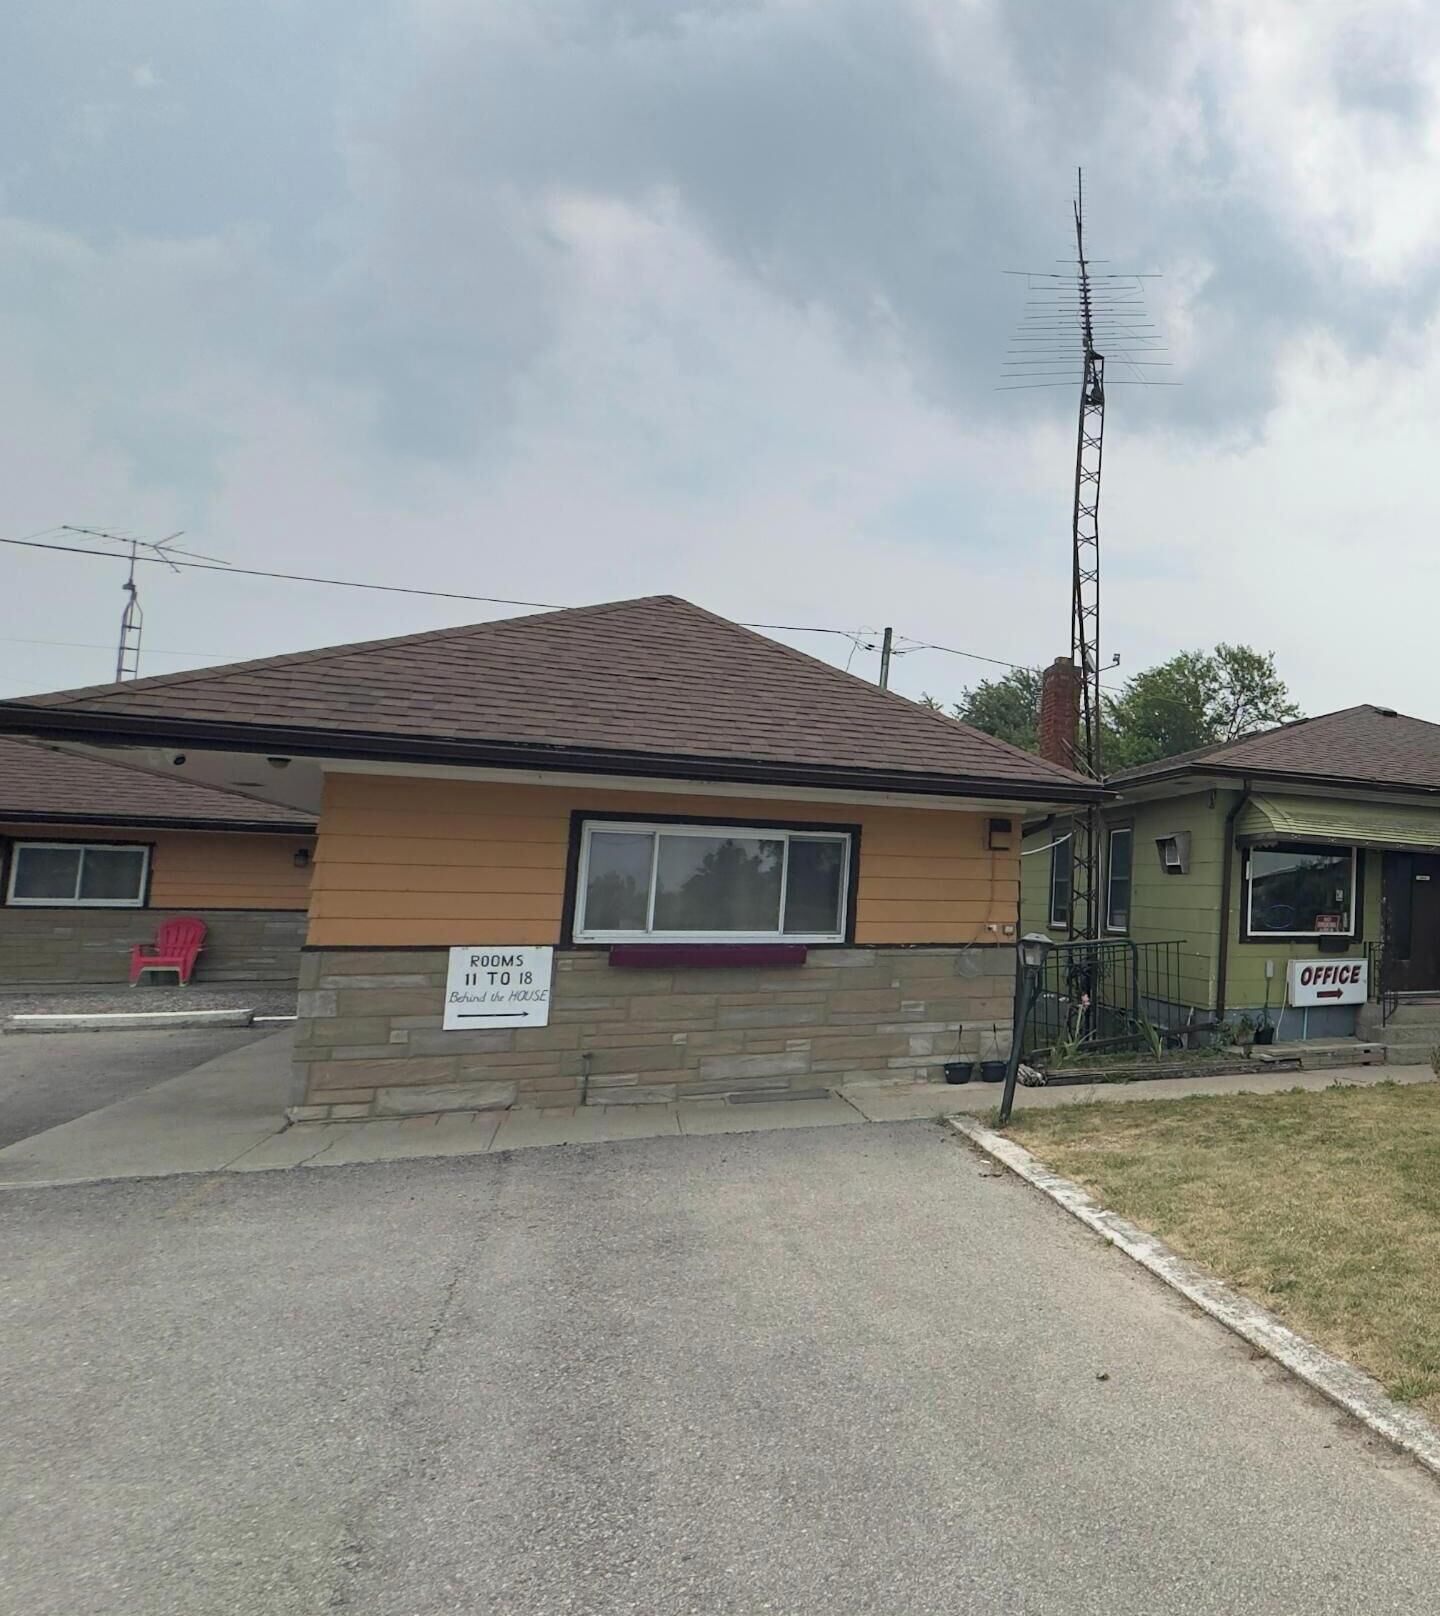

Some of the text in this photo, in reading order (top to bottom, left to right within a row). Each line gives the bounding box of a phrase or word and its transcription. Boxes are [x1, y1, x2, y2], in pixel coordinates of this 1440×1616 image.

[470, 955, 524, 967] ROOMS
[465, 971, 533, 986] 11 TO 18
[1301, 965, 1361, 986] OFFICE
[449, 989, 549, 1003] Behind the HOUSE
